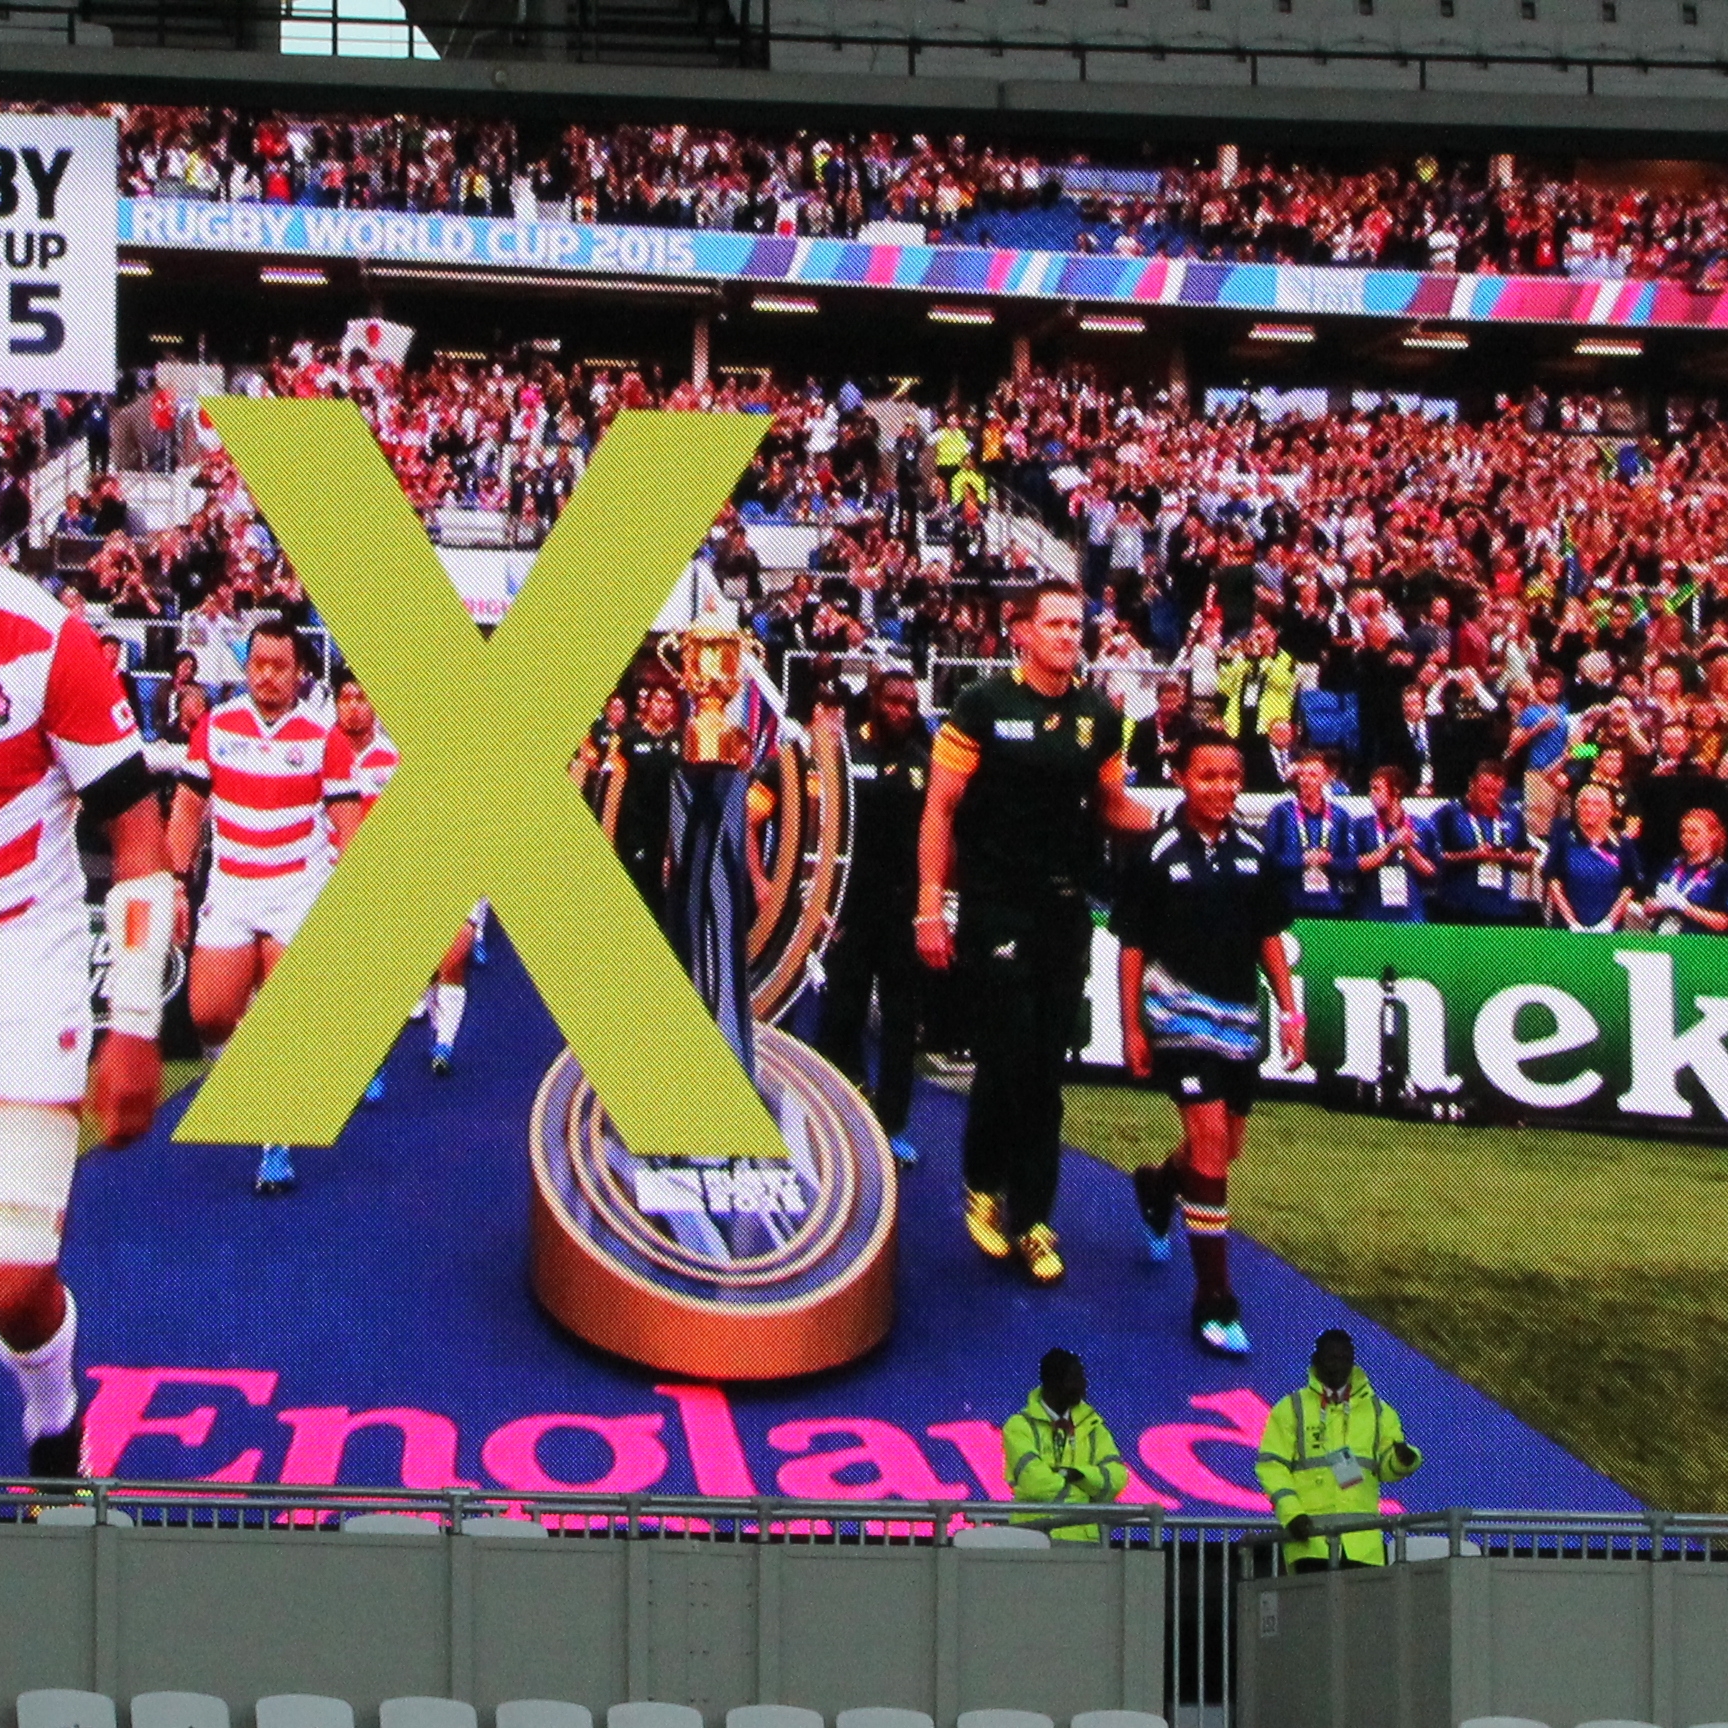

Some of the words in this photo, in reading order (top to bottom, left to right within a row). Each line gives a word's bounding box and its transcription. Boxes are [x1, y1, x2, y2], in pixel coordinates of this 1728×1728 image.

[132, 203, 296, 247] RUGBY
[303, 211, 474, 257] WORLD
[486, 223, 578, 263] CUP
[591, 228, 696, 269] 2015
